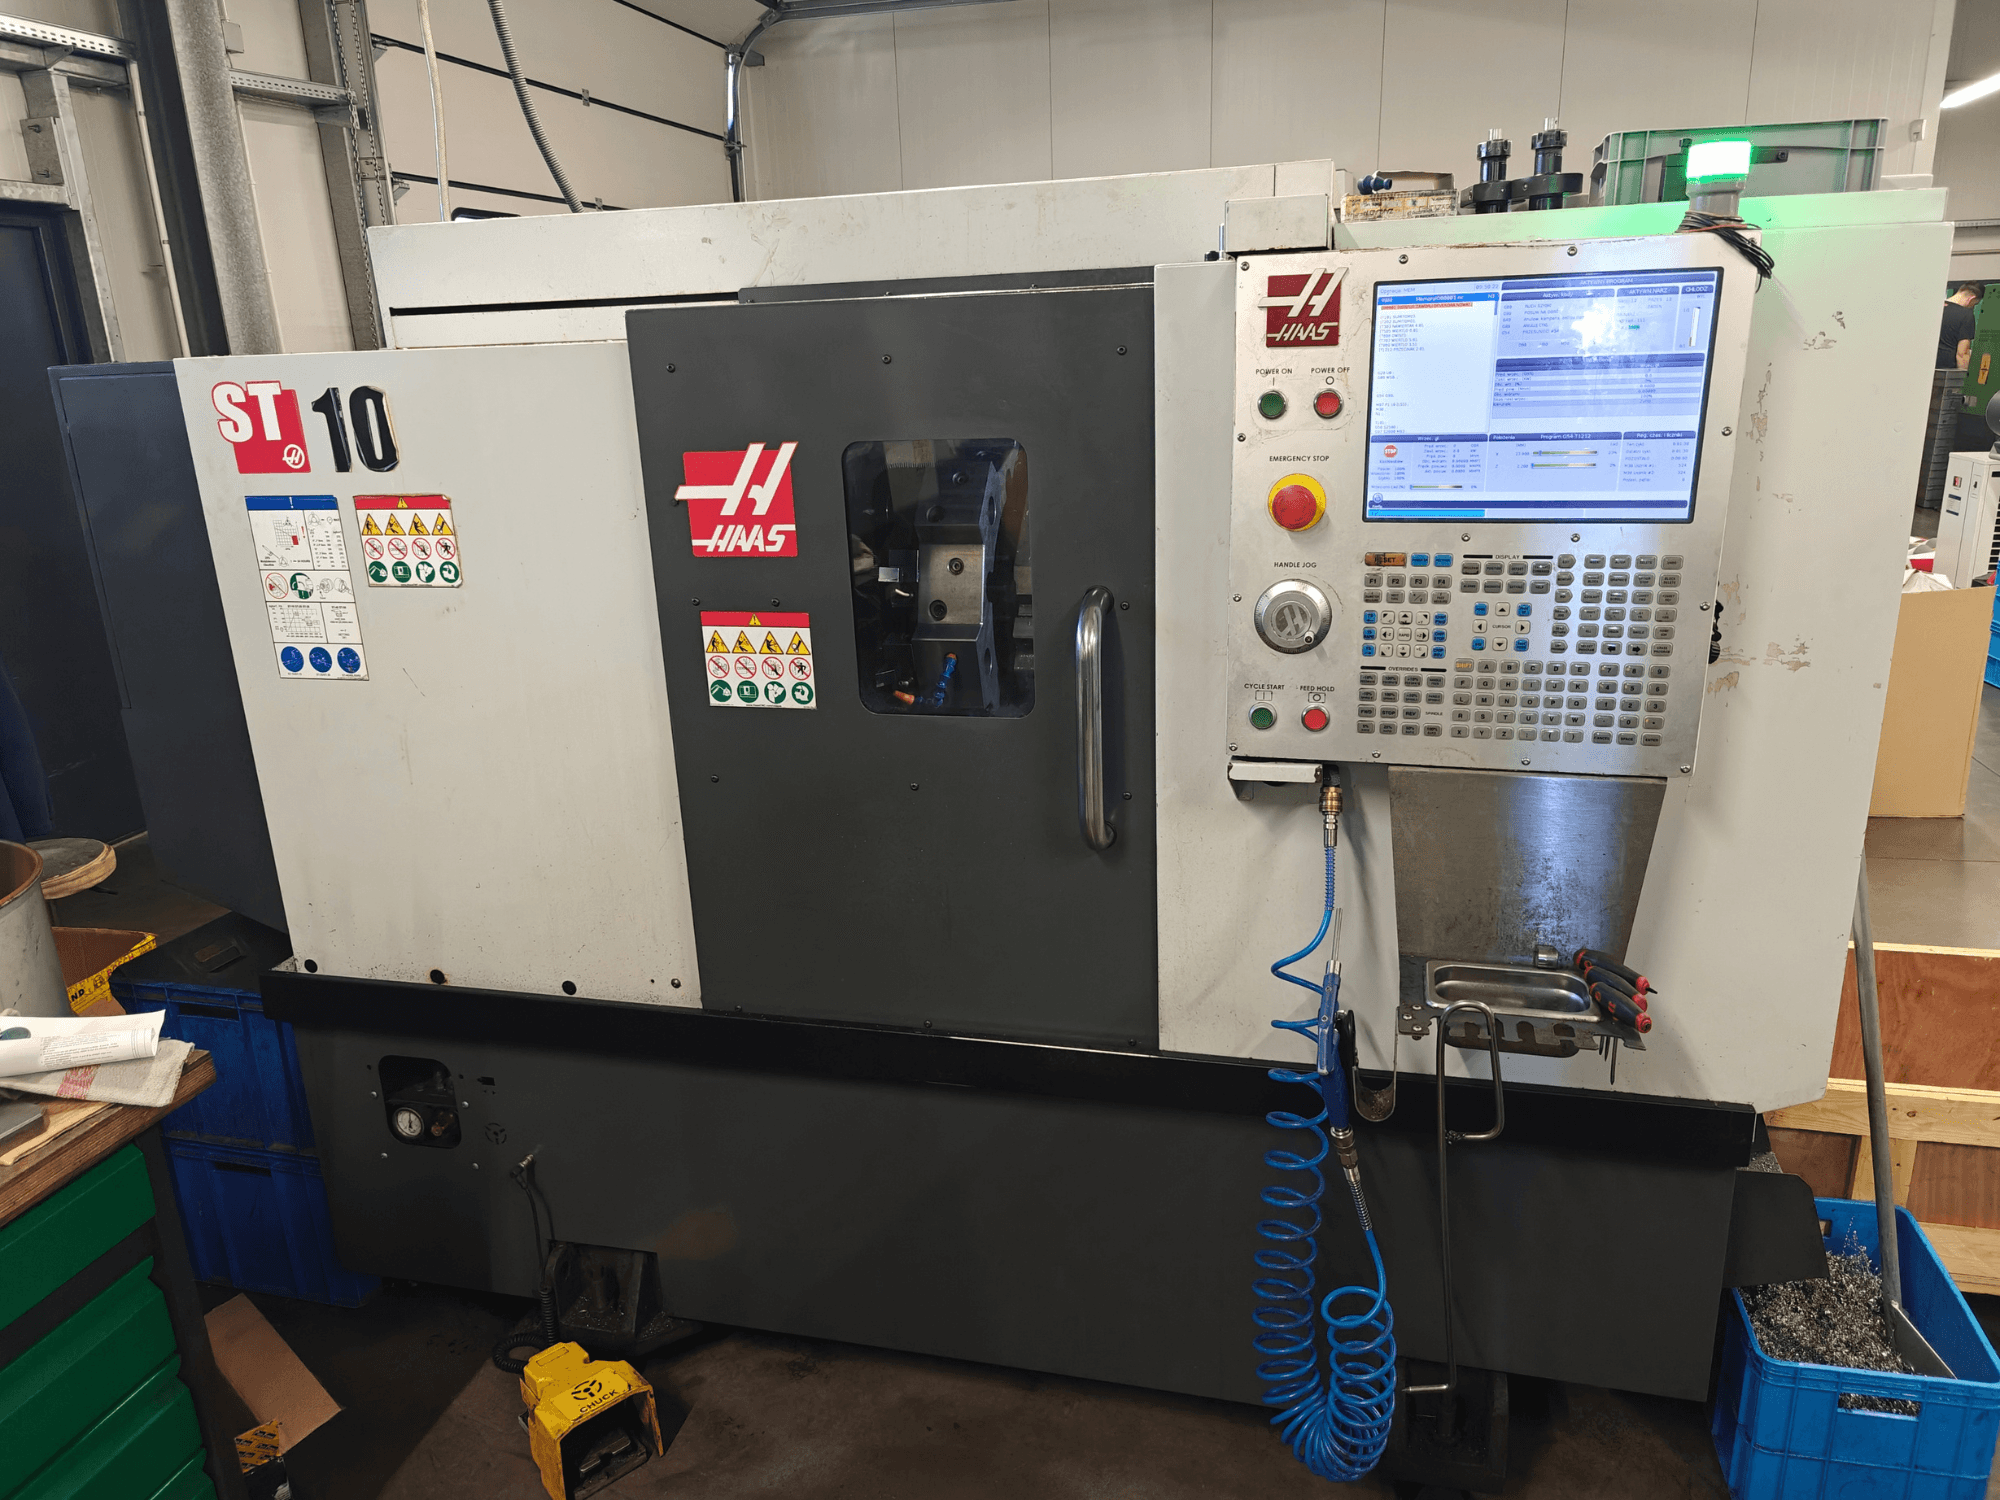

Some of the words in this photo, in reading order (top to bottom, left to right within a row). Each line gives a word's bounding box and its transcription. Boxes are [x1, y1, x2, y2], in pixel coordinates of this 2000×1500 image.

[1267, 322, 1339, 342] HAAS
[212, 380, 282, 443] ST
[311, 385, 399, 473] 10
[692, 524, 796, 552] HAAS
[580, 1389, 618, 1414] CHUCK
